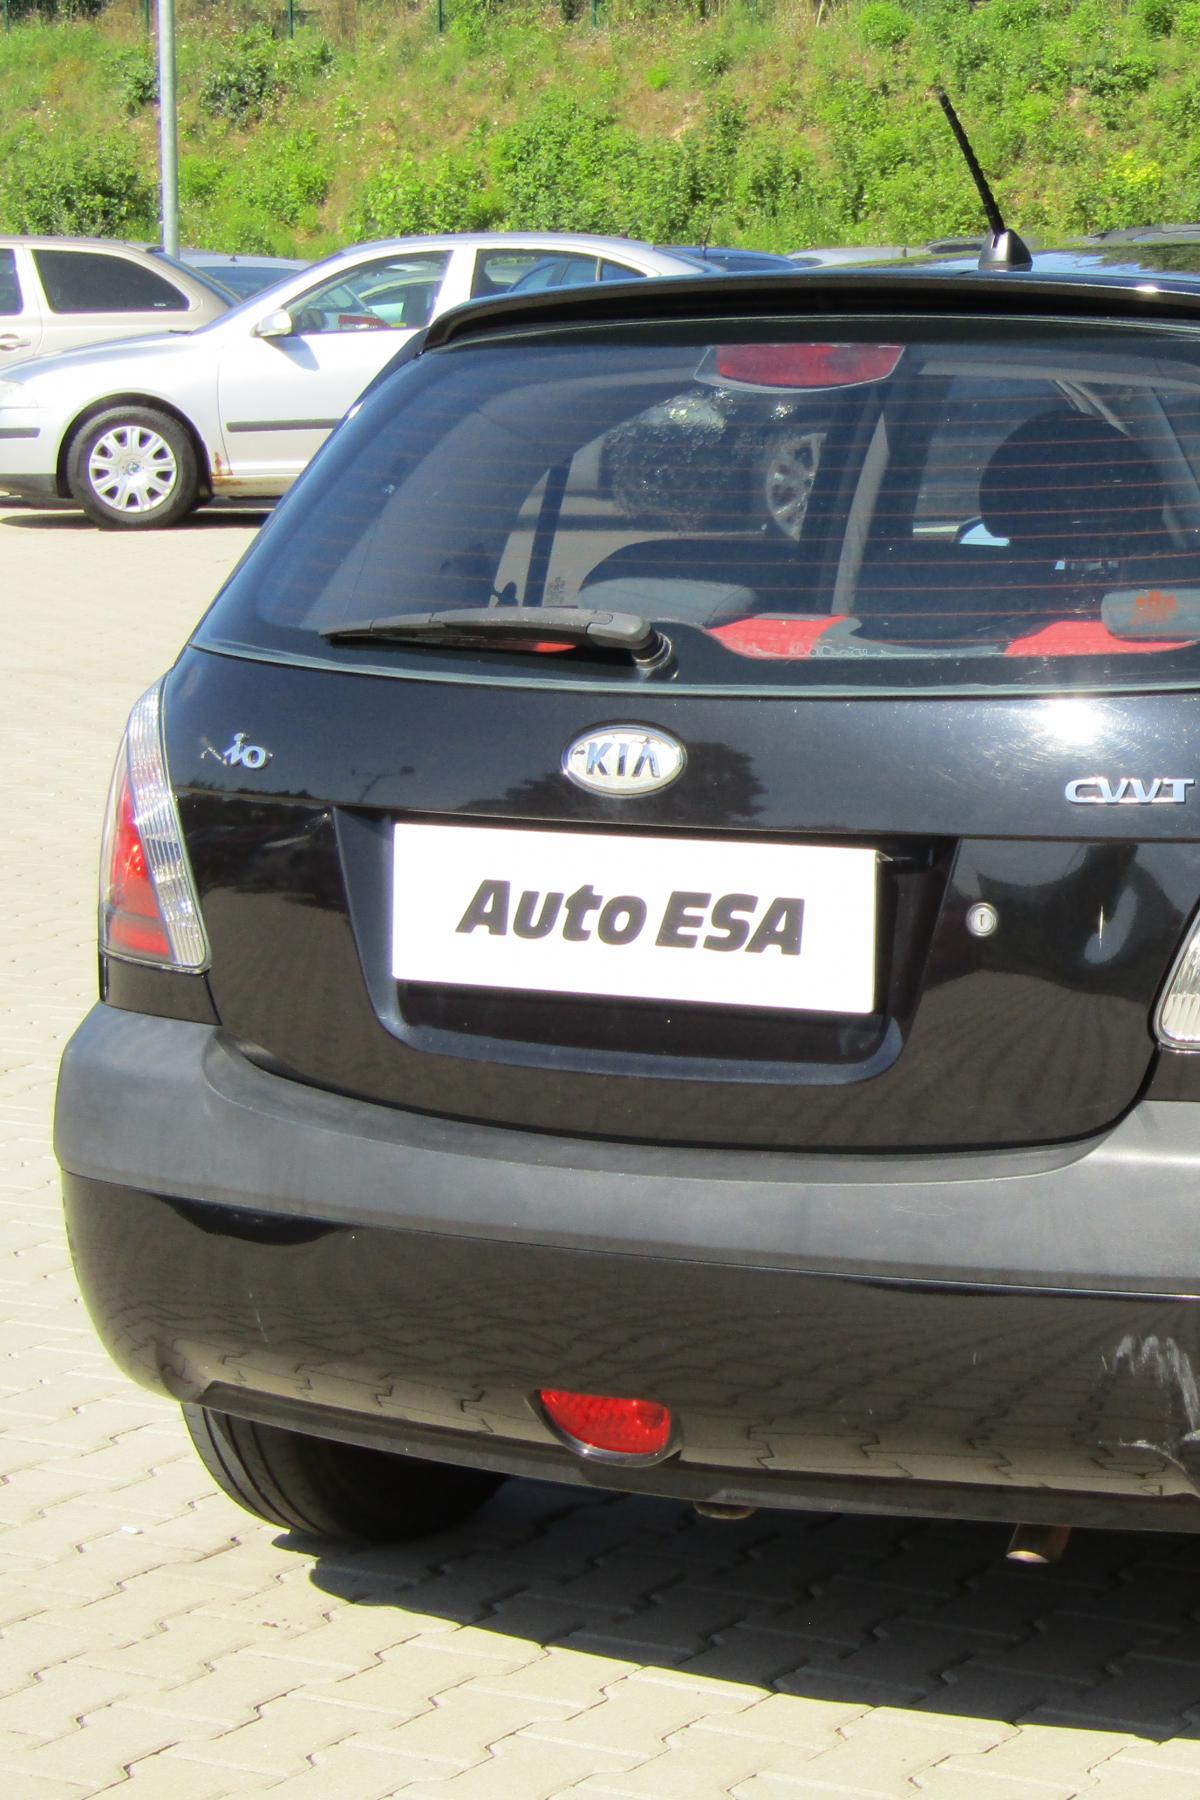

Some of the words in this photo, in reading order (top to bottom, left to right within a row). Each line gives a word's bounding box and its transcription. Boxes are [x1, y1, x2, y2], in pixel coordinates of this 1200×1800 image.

[586, 741, 661, 778] KIA
[1064, 776, 1195, 804] CVVT
[455, 879, 648, 946] Auto
[655, 890, 806, 956] ESA
